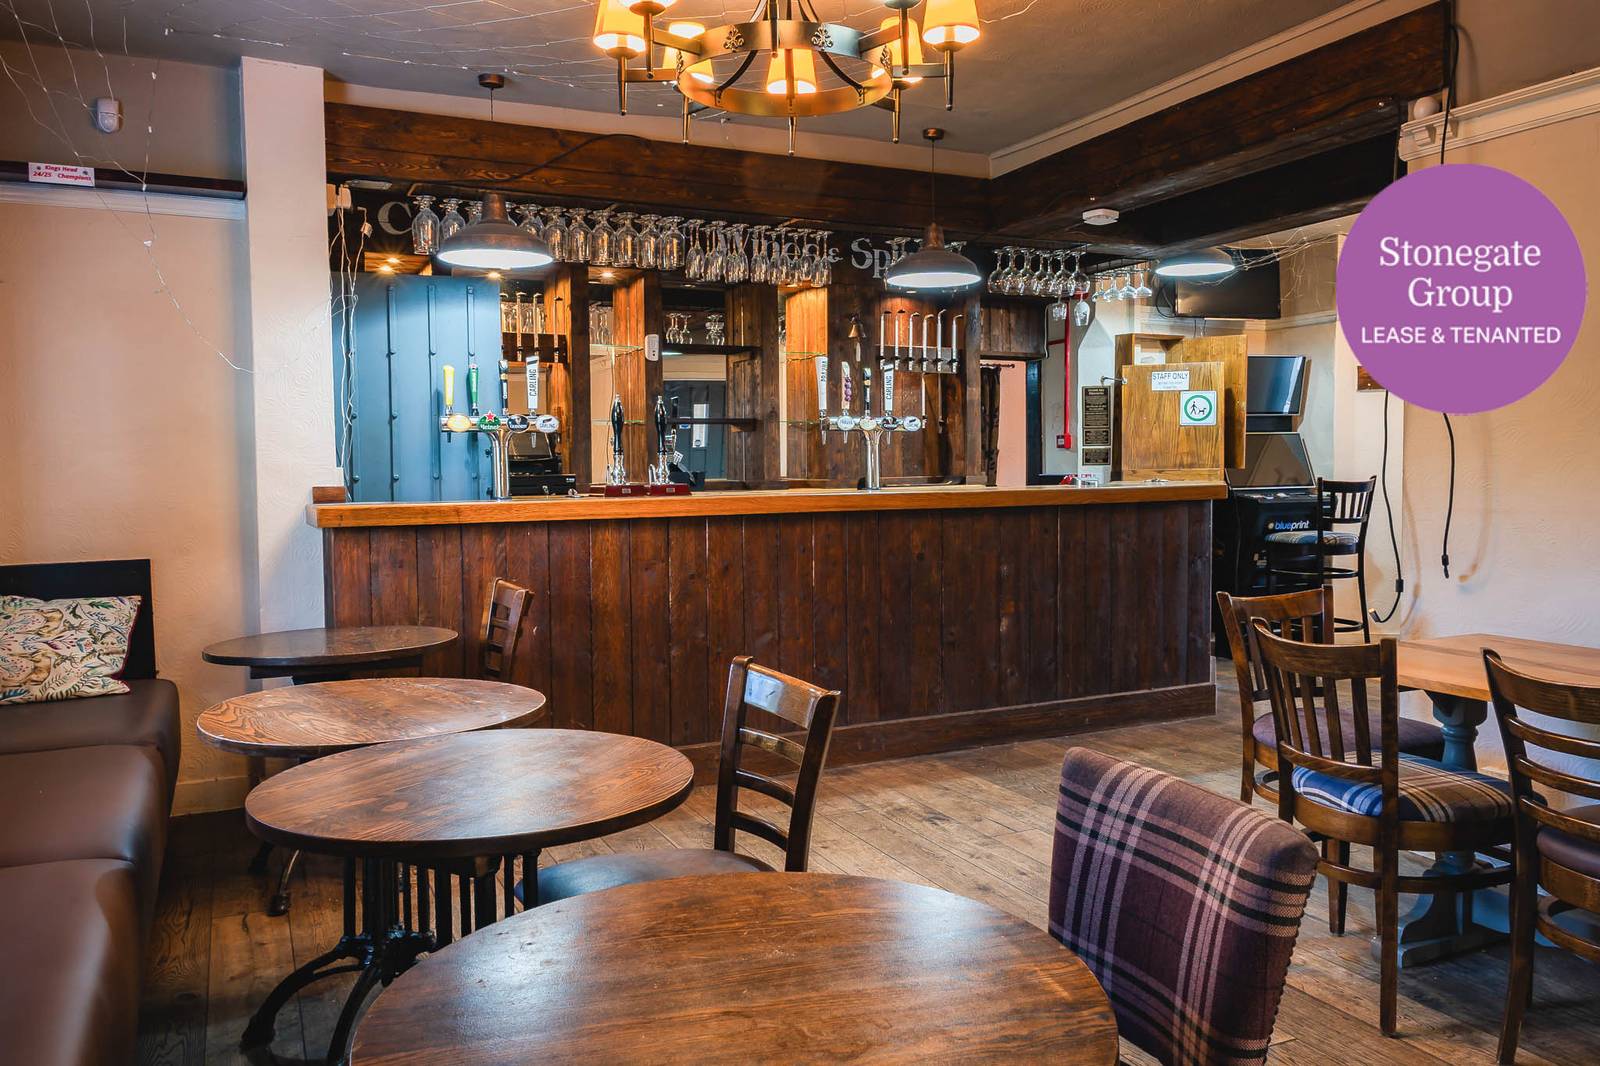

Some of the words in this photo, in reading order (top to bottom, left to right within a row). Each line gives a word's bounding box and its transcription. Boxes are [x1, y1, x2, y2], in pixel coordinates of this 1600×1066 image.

[57, 173, 92, 181] Champions
[1152, 372, 1172, 380] STAFF
[1172, 372, 1188, 380] ONLY
[529, 368, 537, 397] CARLING
[1274, 520, 1310, 532] blueprint
